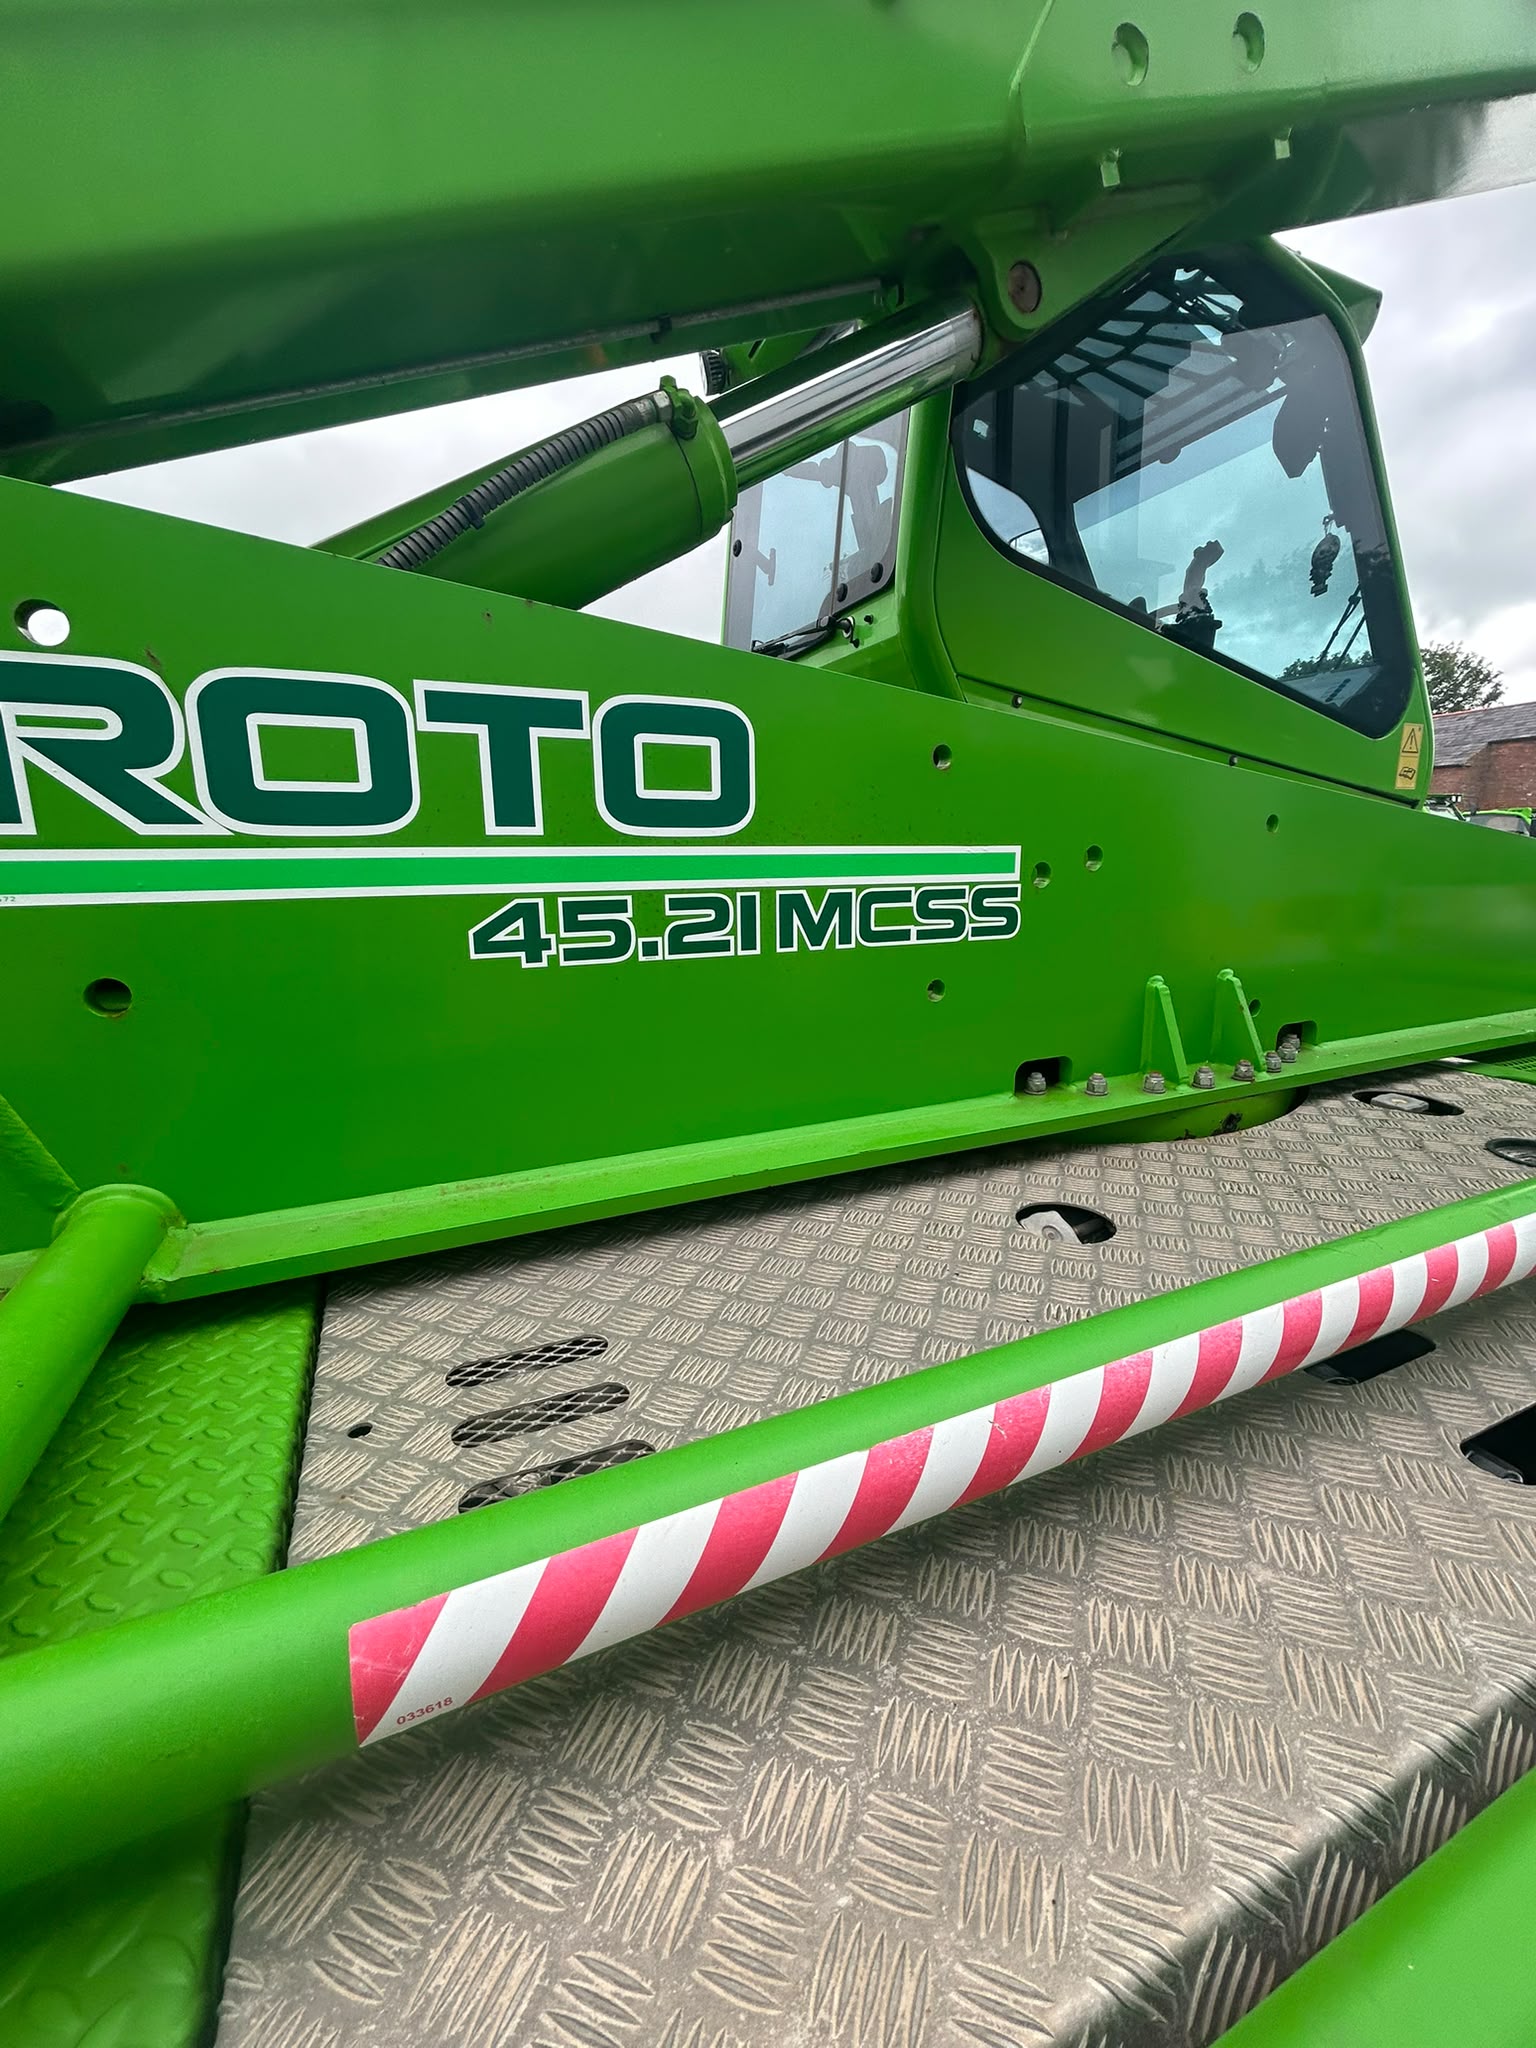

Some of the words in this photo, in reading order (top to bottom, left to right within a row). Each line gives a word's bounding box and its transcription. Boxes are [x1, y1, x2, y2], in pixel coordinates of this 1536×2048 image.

[0, 650, 755, 836] ROTO
[468, 890, 761, 969] 45.21
[776, 883, 1023, 952] MCSS
[397, 1697, 453, 1725] 033618
